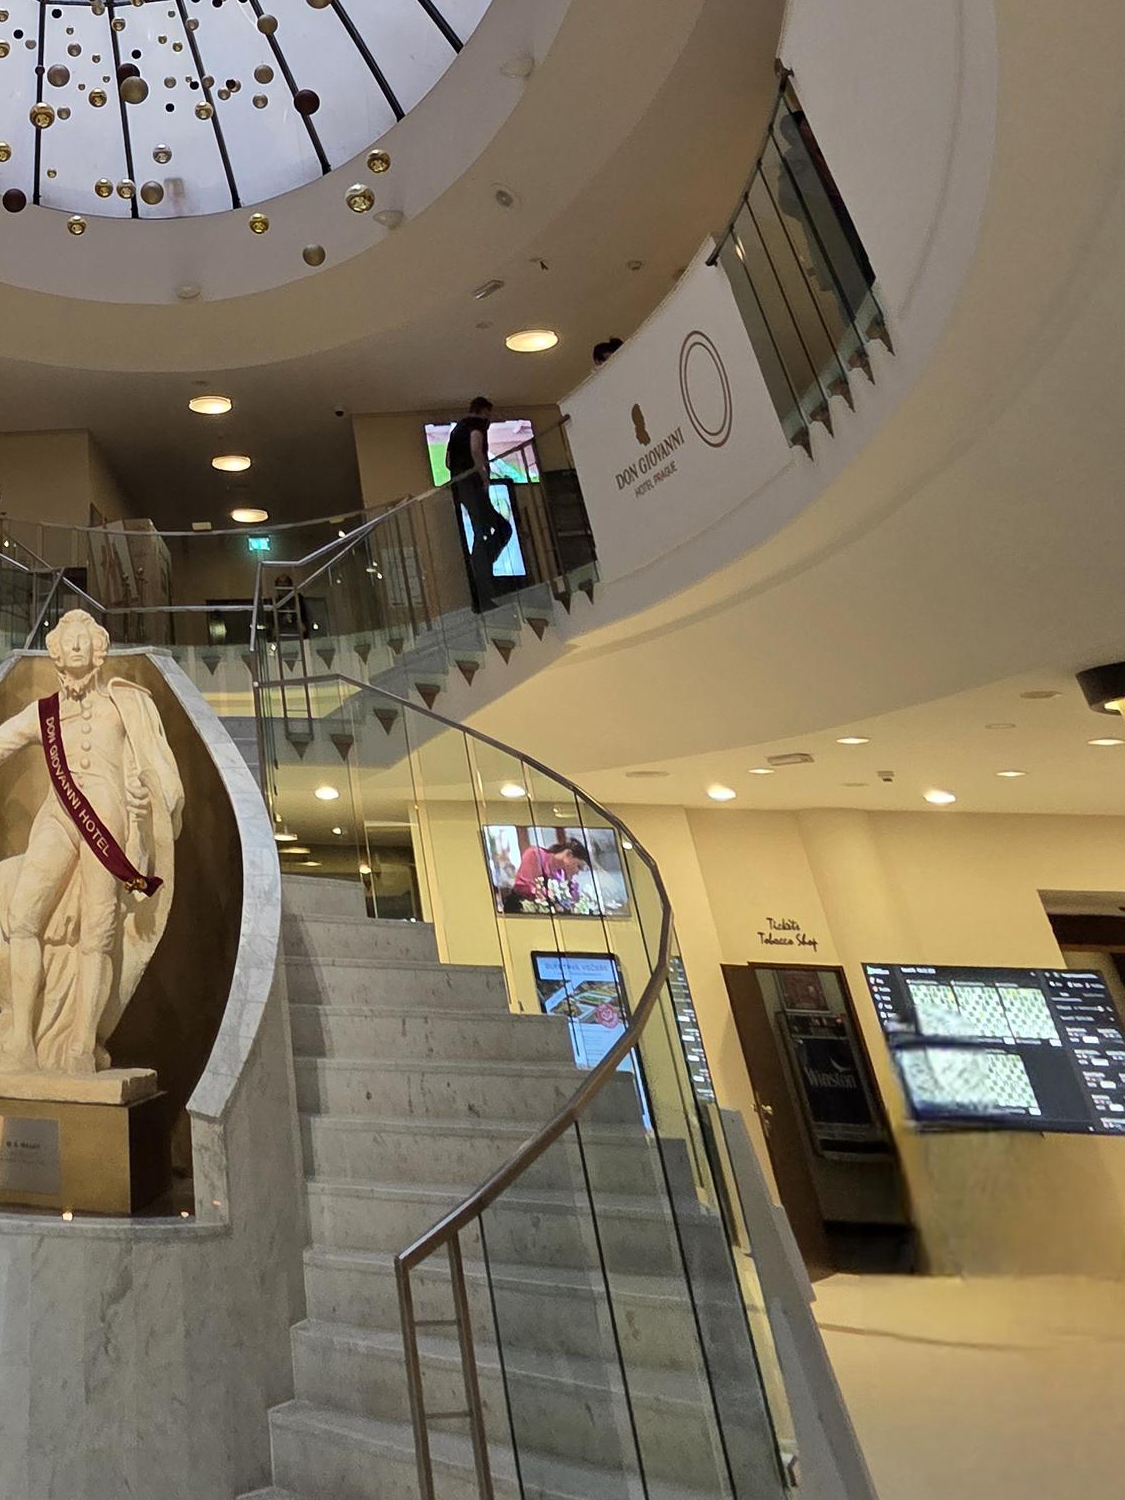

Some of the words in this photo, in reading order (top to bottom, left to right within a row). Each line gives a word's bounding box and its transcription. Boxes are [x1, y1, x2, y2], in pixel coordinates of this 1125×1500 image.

[615, 463, 639, 491] DON
[638, 426, 685, 475] GIOVANNI
[45, 716, 57, 744] DON
[49, 747, 82, 810] GIOVANNI
[78, 811, 110, 858] HOTEL
[757, 932, 795, 946] Tobacco
[795, 933, 819, 953] Shop
